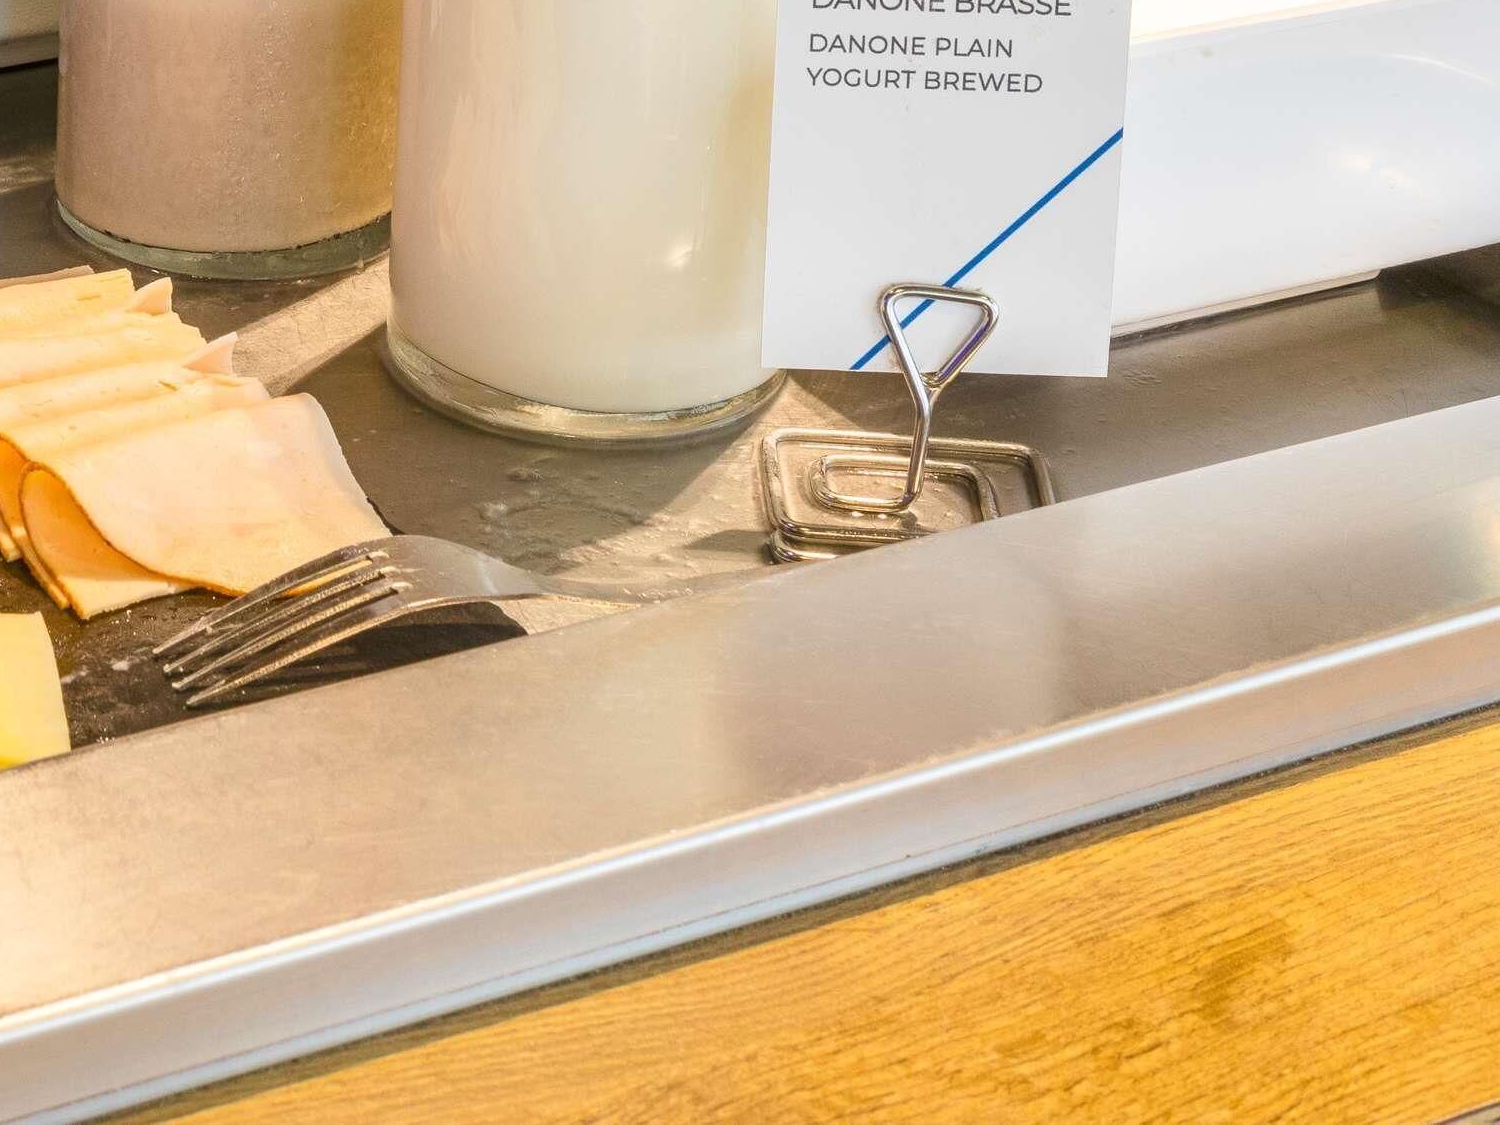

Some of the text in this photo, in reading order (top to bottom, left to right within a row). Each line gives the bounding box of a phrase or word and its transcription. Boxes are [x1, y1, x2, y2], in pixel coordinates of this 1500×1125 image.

[809, 33, 1013, 58] DANONE PLAIN
[806, 67, 1043, 93] YOGURT BREWED
